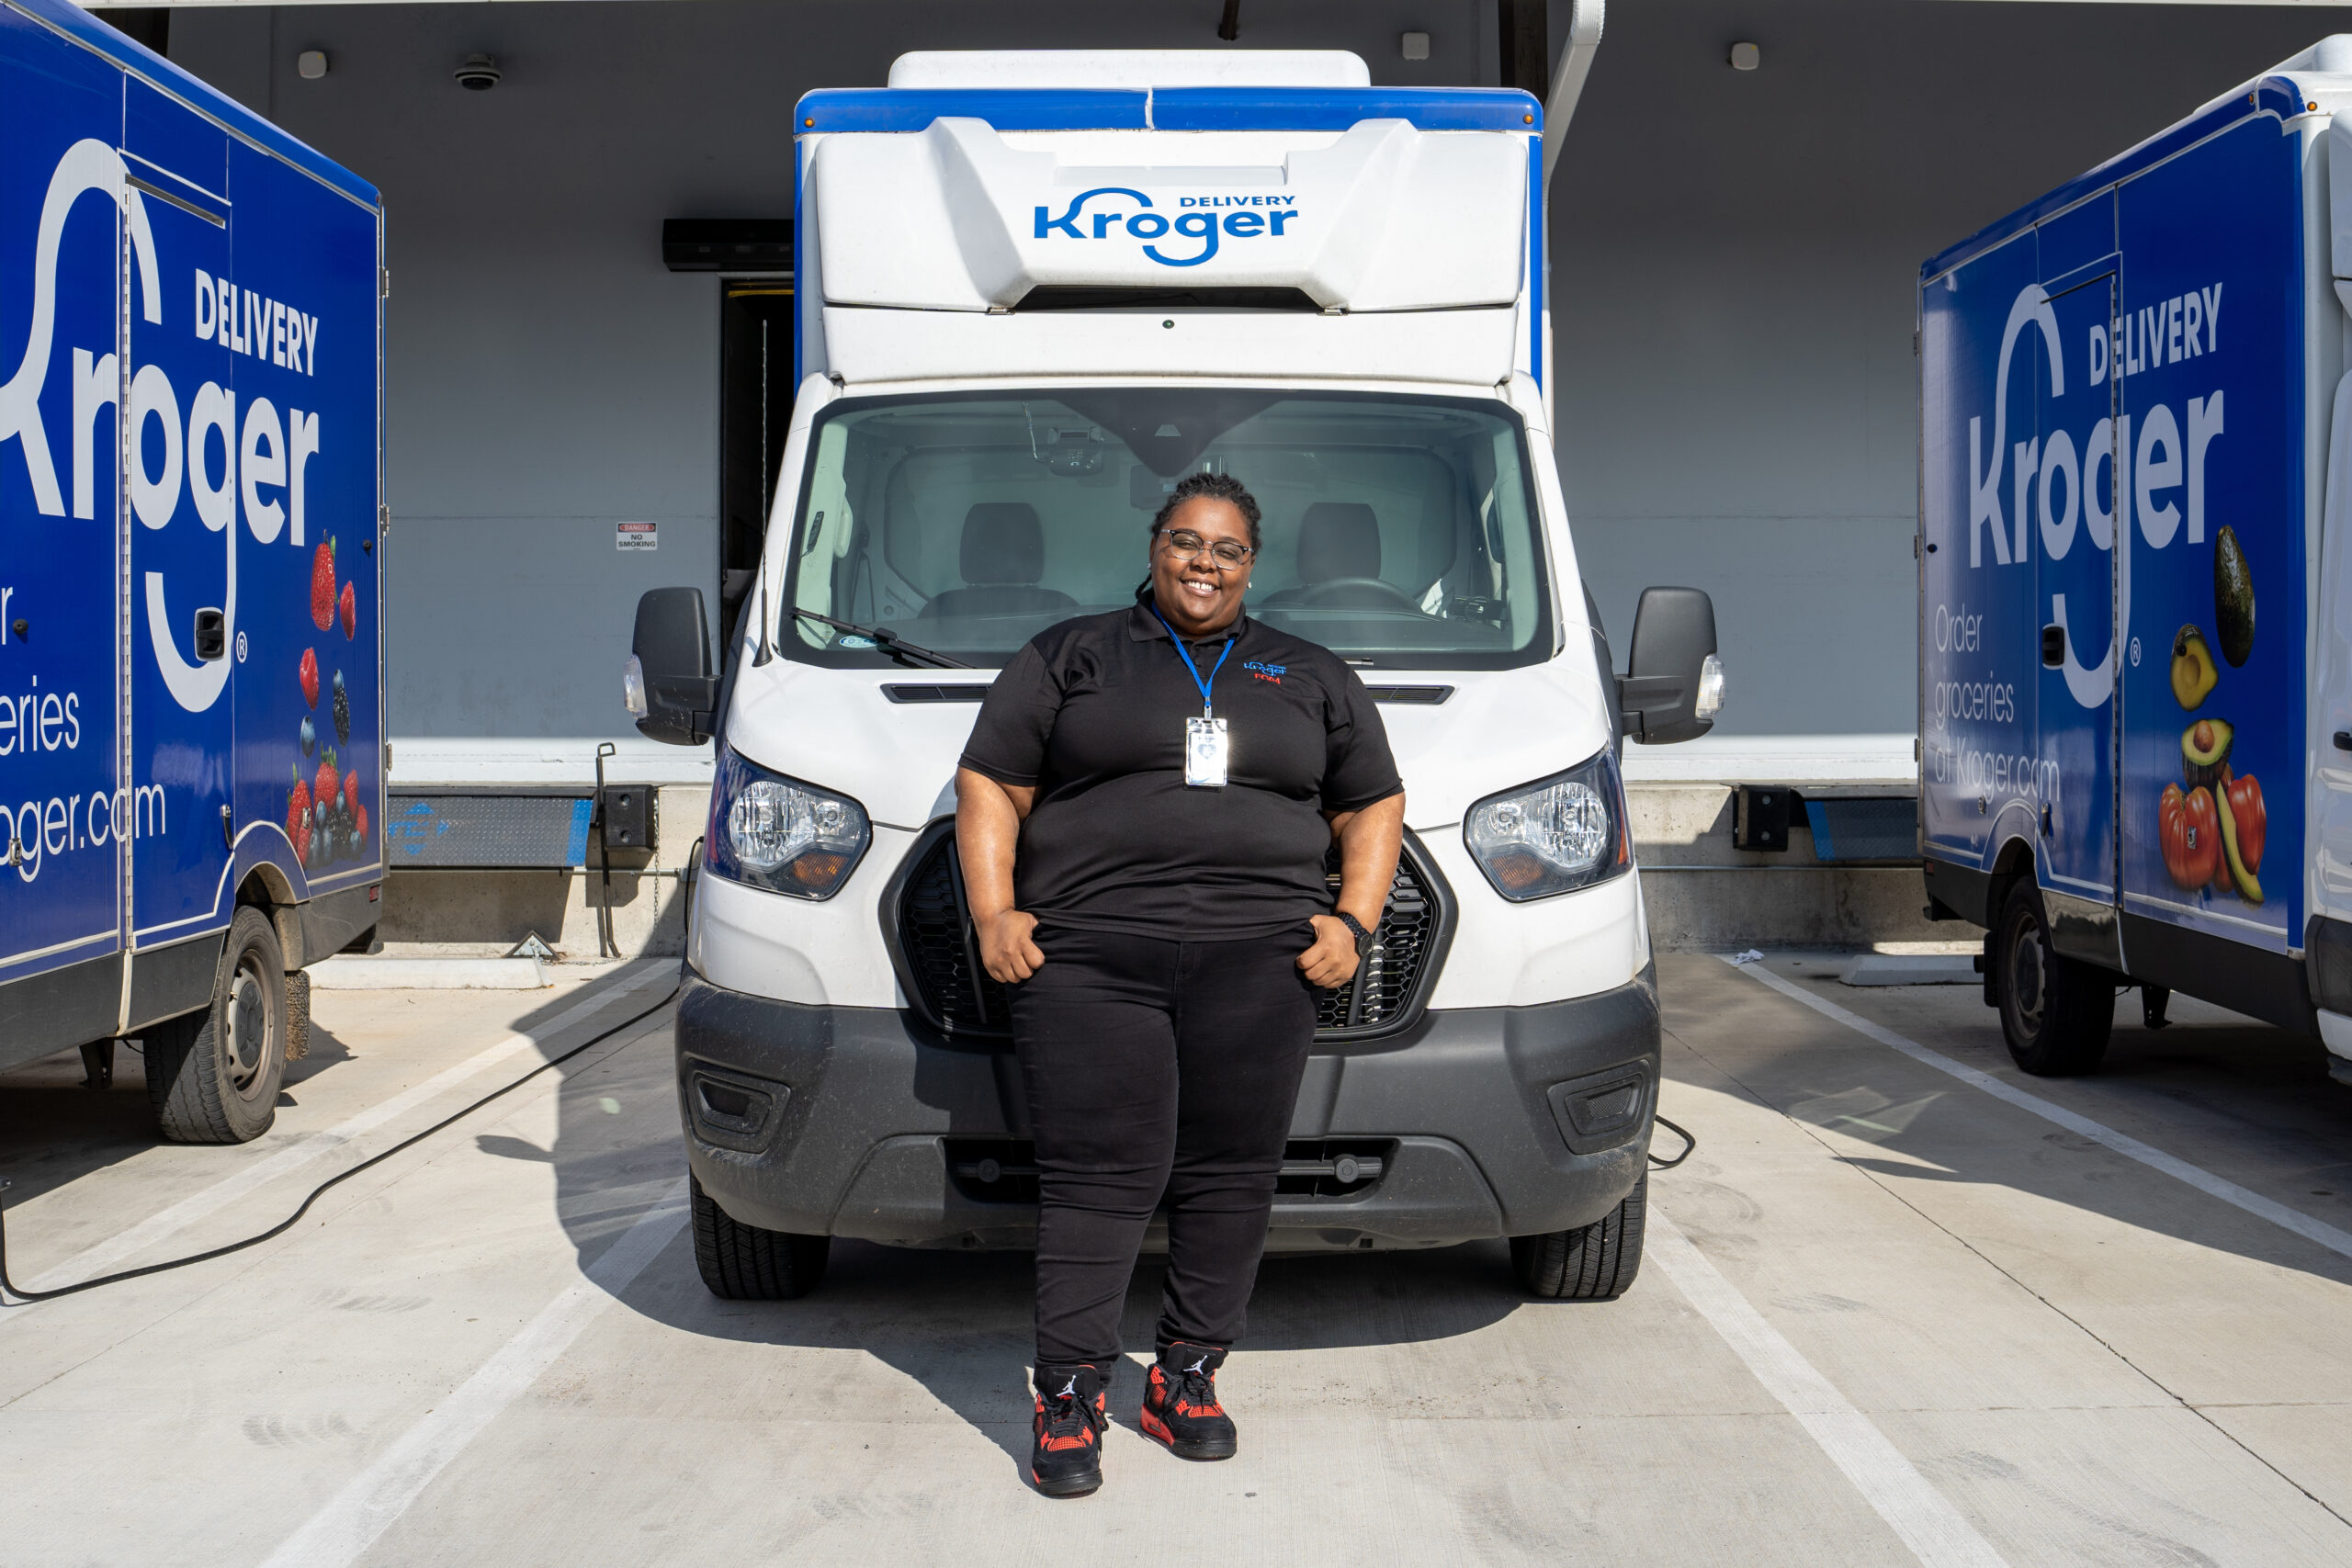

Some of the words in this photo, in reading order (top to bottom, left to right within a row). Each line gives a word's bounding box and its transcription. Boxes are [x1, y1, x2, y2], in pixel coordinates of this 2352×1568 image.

[1034, 187, 1298, 266] Kroger
[1180, 196, 1295, 208] DELIVERY
[196, 268, 318, 377] DELIVERY
[2089, 282, 2222, 387] DELIVERY
[1970, 284, 2223, 709] Kroger
[1935, 603, 1983, 652] Order
[1935, 670, 2014, 731] groceries
[1935, 737, 1951, 783] at
[1957, 737, 2060, 805] Kroger.com
